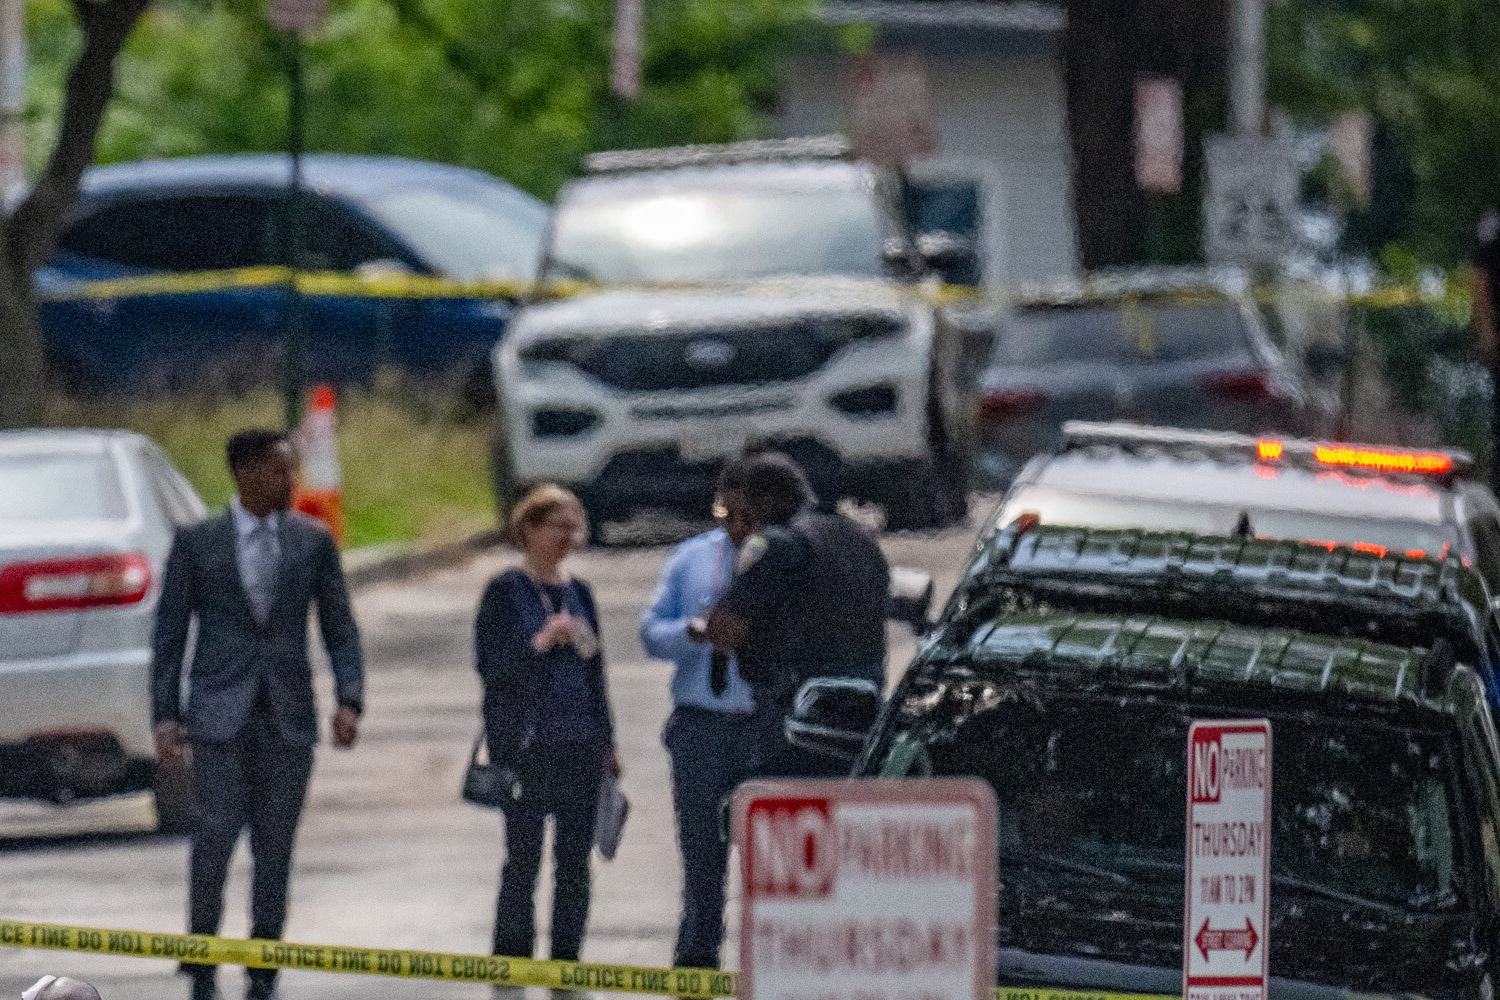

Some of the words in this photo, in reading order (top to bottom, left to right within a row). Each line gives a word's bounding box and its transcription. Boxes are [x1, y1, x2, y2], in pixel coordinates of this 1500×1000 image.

[1194, 742, 1219, 798] NO
[1222, 749, 1264, 788] PARKING
[752, 811, 832, 889] NO
[840, 822, 973, 878] PARKING
[1195, 822, 1263, 856] THURSDAY
[1224, 875, 1235, 903] TO
